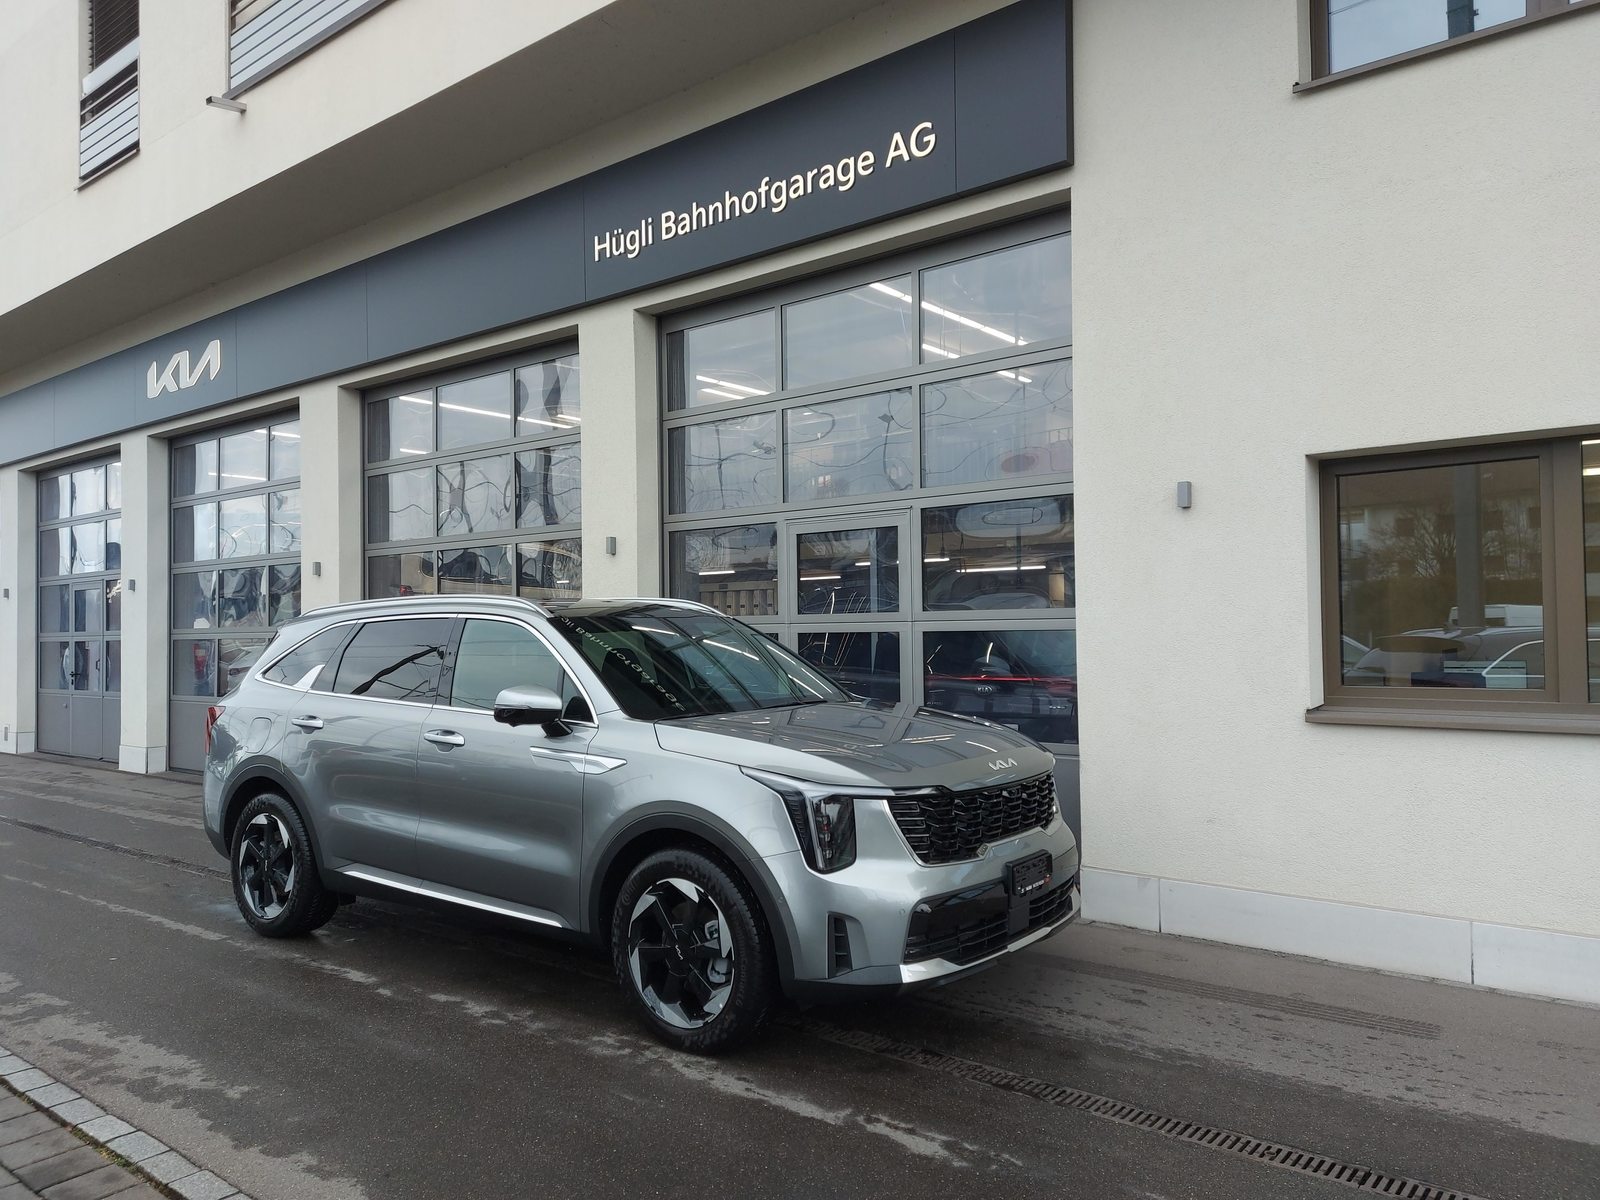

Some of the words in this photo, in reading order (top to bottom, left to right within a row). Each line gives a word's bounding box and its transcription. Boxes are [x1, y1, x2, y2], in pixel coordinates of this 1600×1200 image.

[594, 217, 654, 262] Hügli
[661, 150, 876, 241] Bahnhofgarage
[885, 121, 938, 168] AG
[147, 339, 221, 399] KIA
